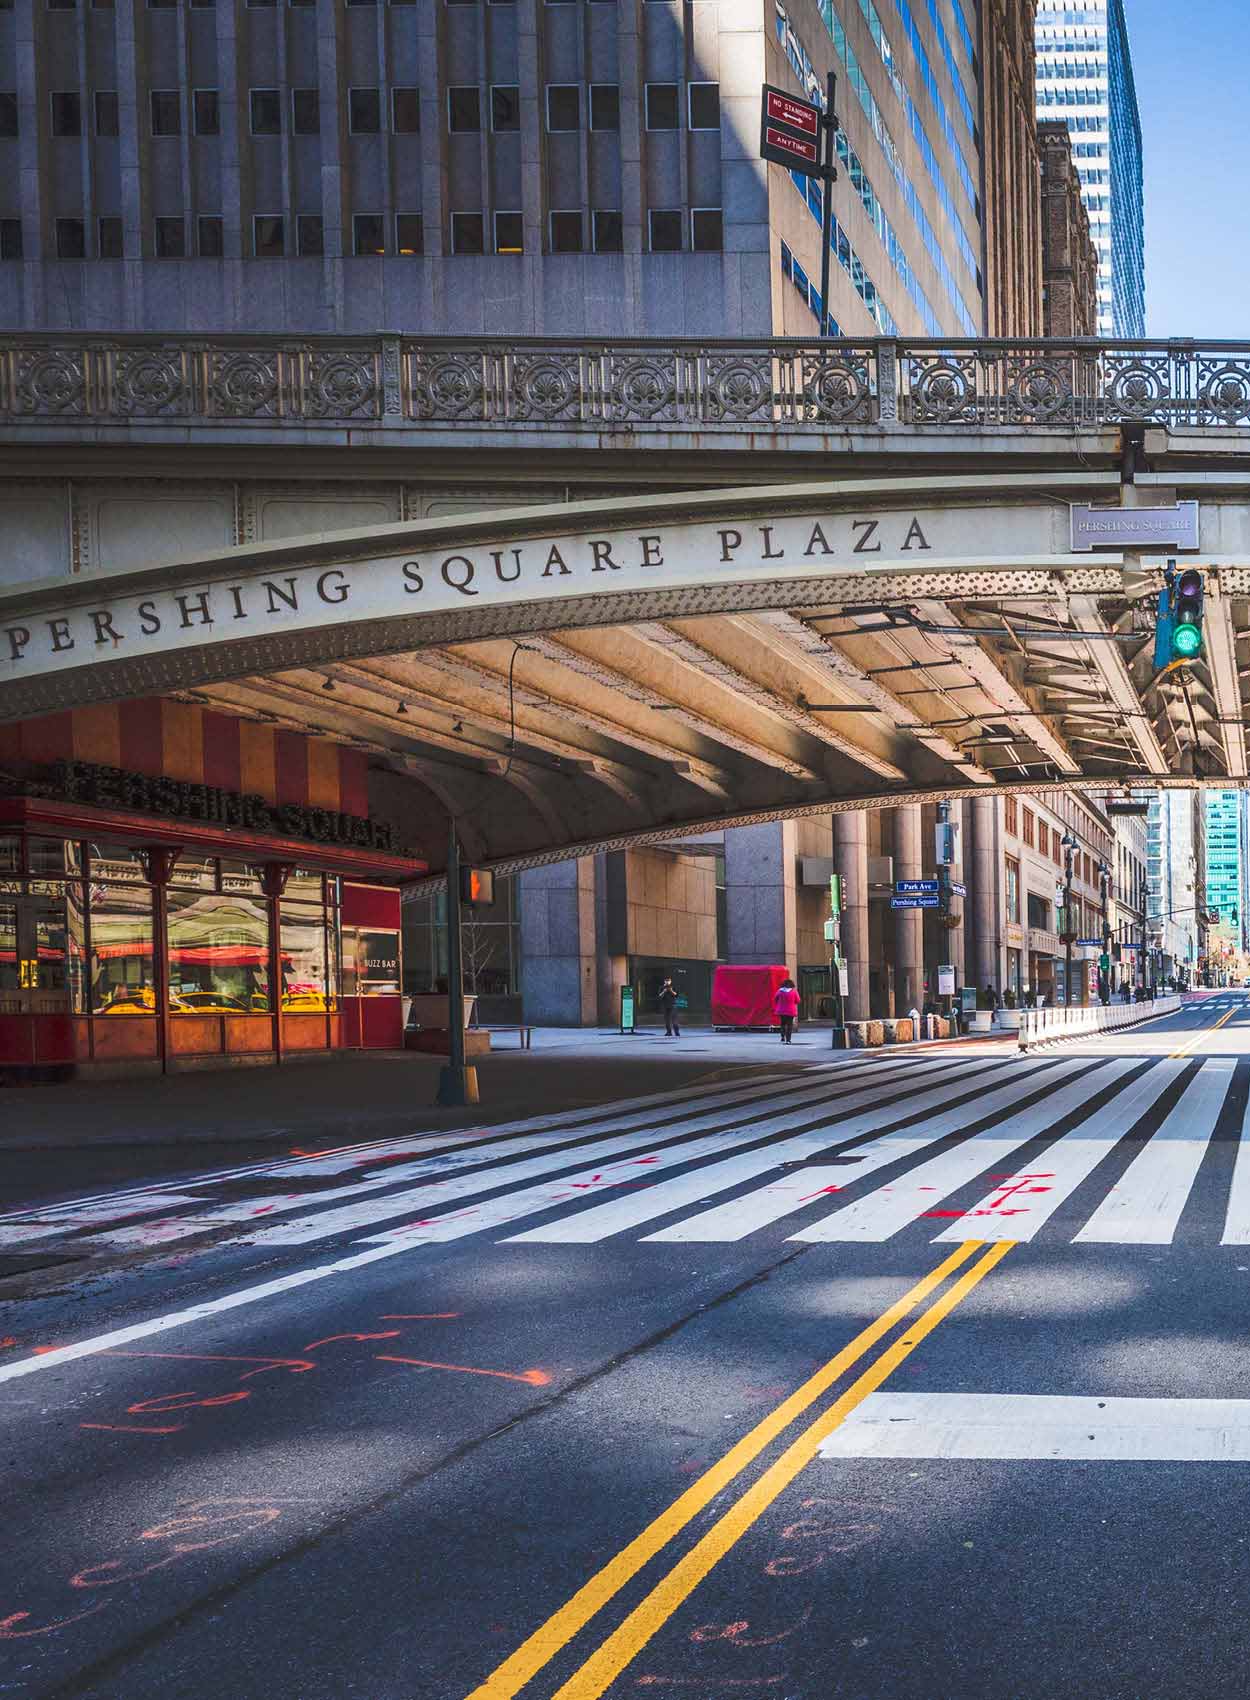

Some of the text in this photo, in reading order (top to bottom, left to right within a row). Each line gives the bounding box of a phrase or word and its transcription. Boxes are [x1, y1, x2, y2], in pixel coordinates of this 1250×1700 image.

[773, 98, 813, 121] NO STANDING
[776, 136, 807, 153] ANYTIME
[1078, 519, 1192, 532] PERSHING SQUARE
[4, 517, 932, 660] PERSHING SQUARE PLAZA
[918, 898, 938, 906] Square
[381, 959, 396, 968] BAR
